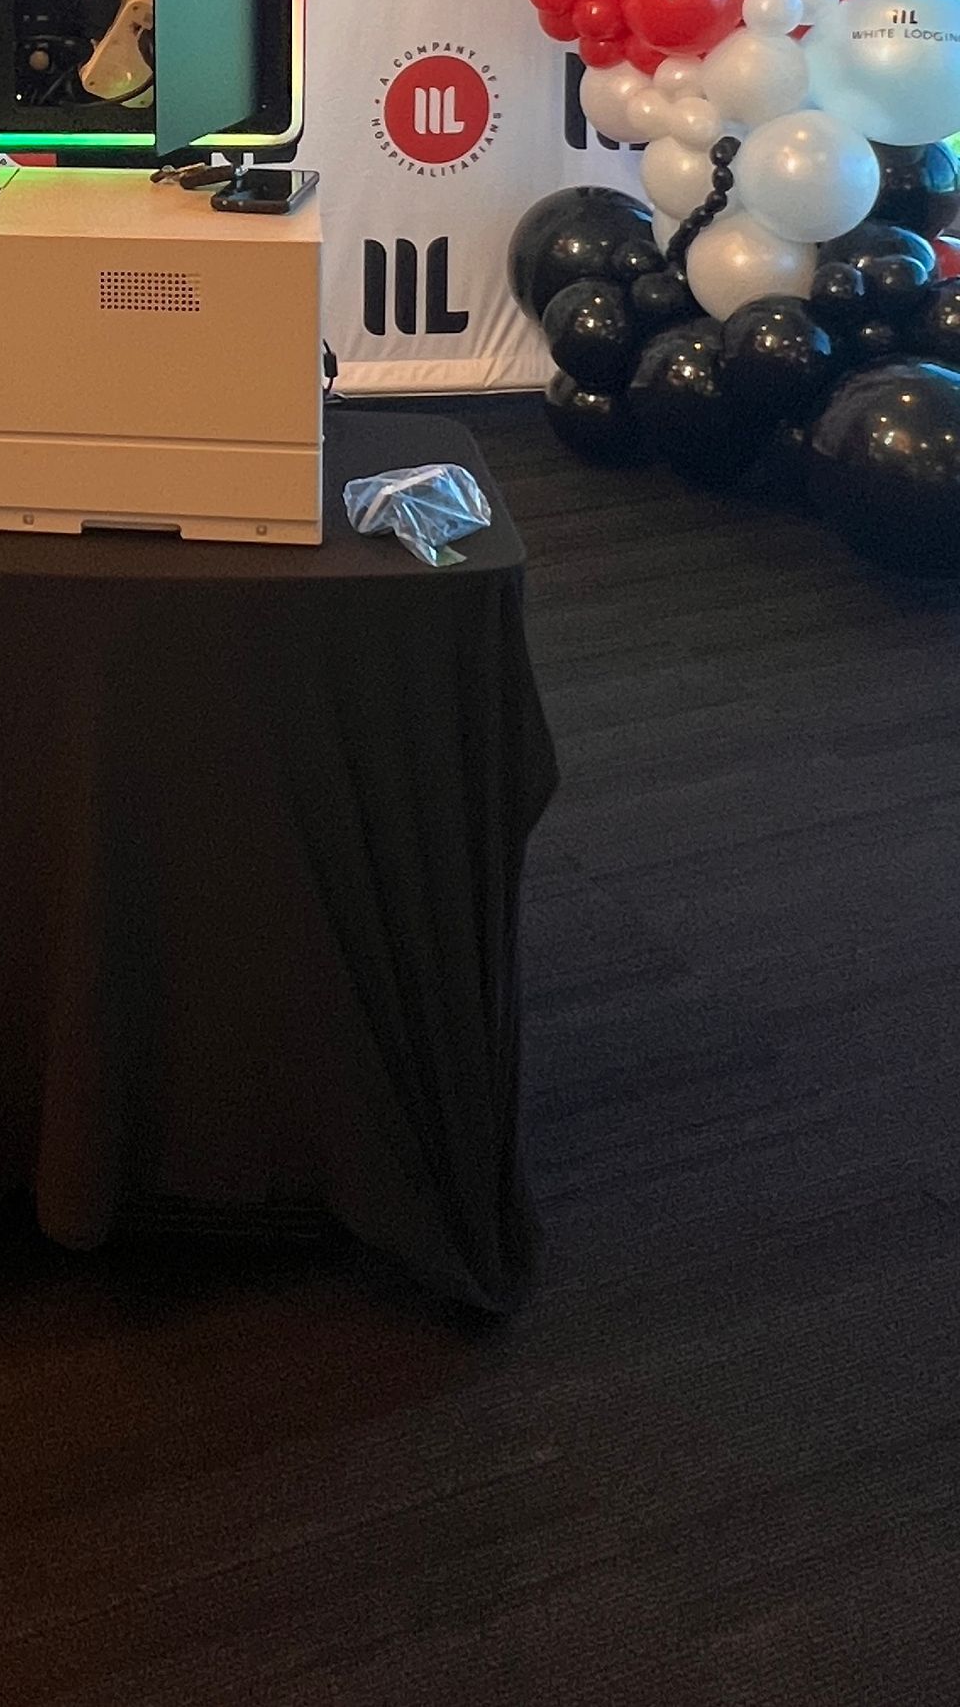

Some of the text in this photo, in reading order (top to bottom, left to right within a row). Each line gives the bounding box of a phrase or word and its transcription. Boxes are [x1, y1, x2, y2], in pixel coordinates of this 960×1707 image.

[852, 28, 960, 42] WHITE LODGIN
[371, 42, 502, 177] A COMPANY OF HOSPITALITARIANS
